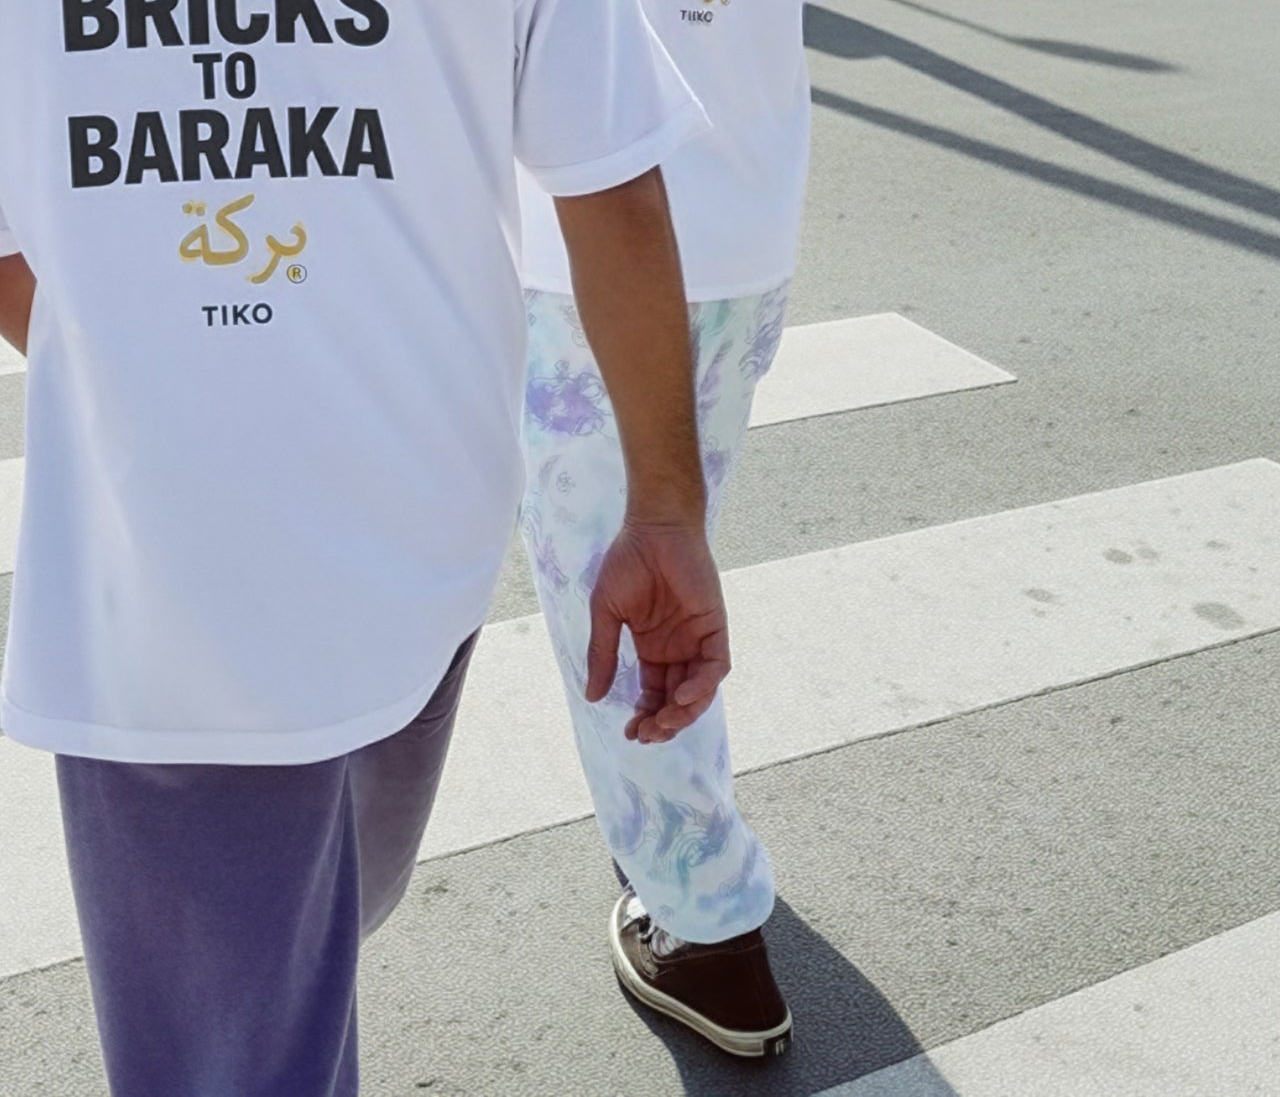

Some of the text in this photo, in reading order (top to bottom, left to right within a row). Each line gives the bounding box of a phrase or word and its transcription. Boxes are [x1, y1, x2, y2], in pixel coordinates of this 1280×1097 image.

[192, 51, 257, 100] TO
[67, 106, 394, 189] BARAKA
[201, 302, 273, 327] TIKO
